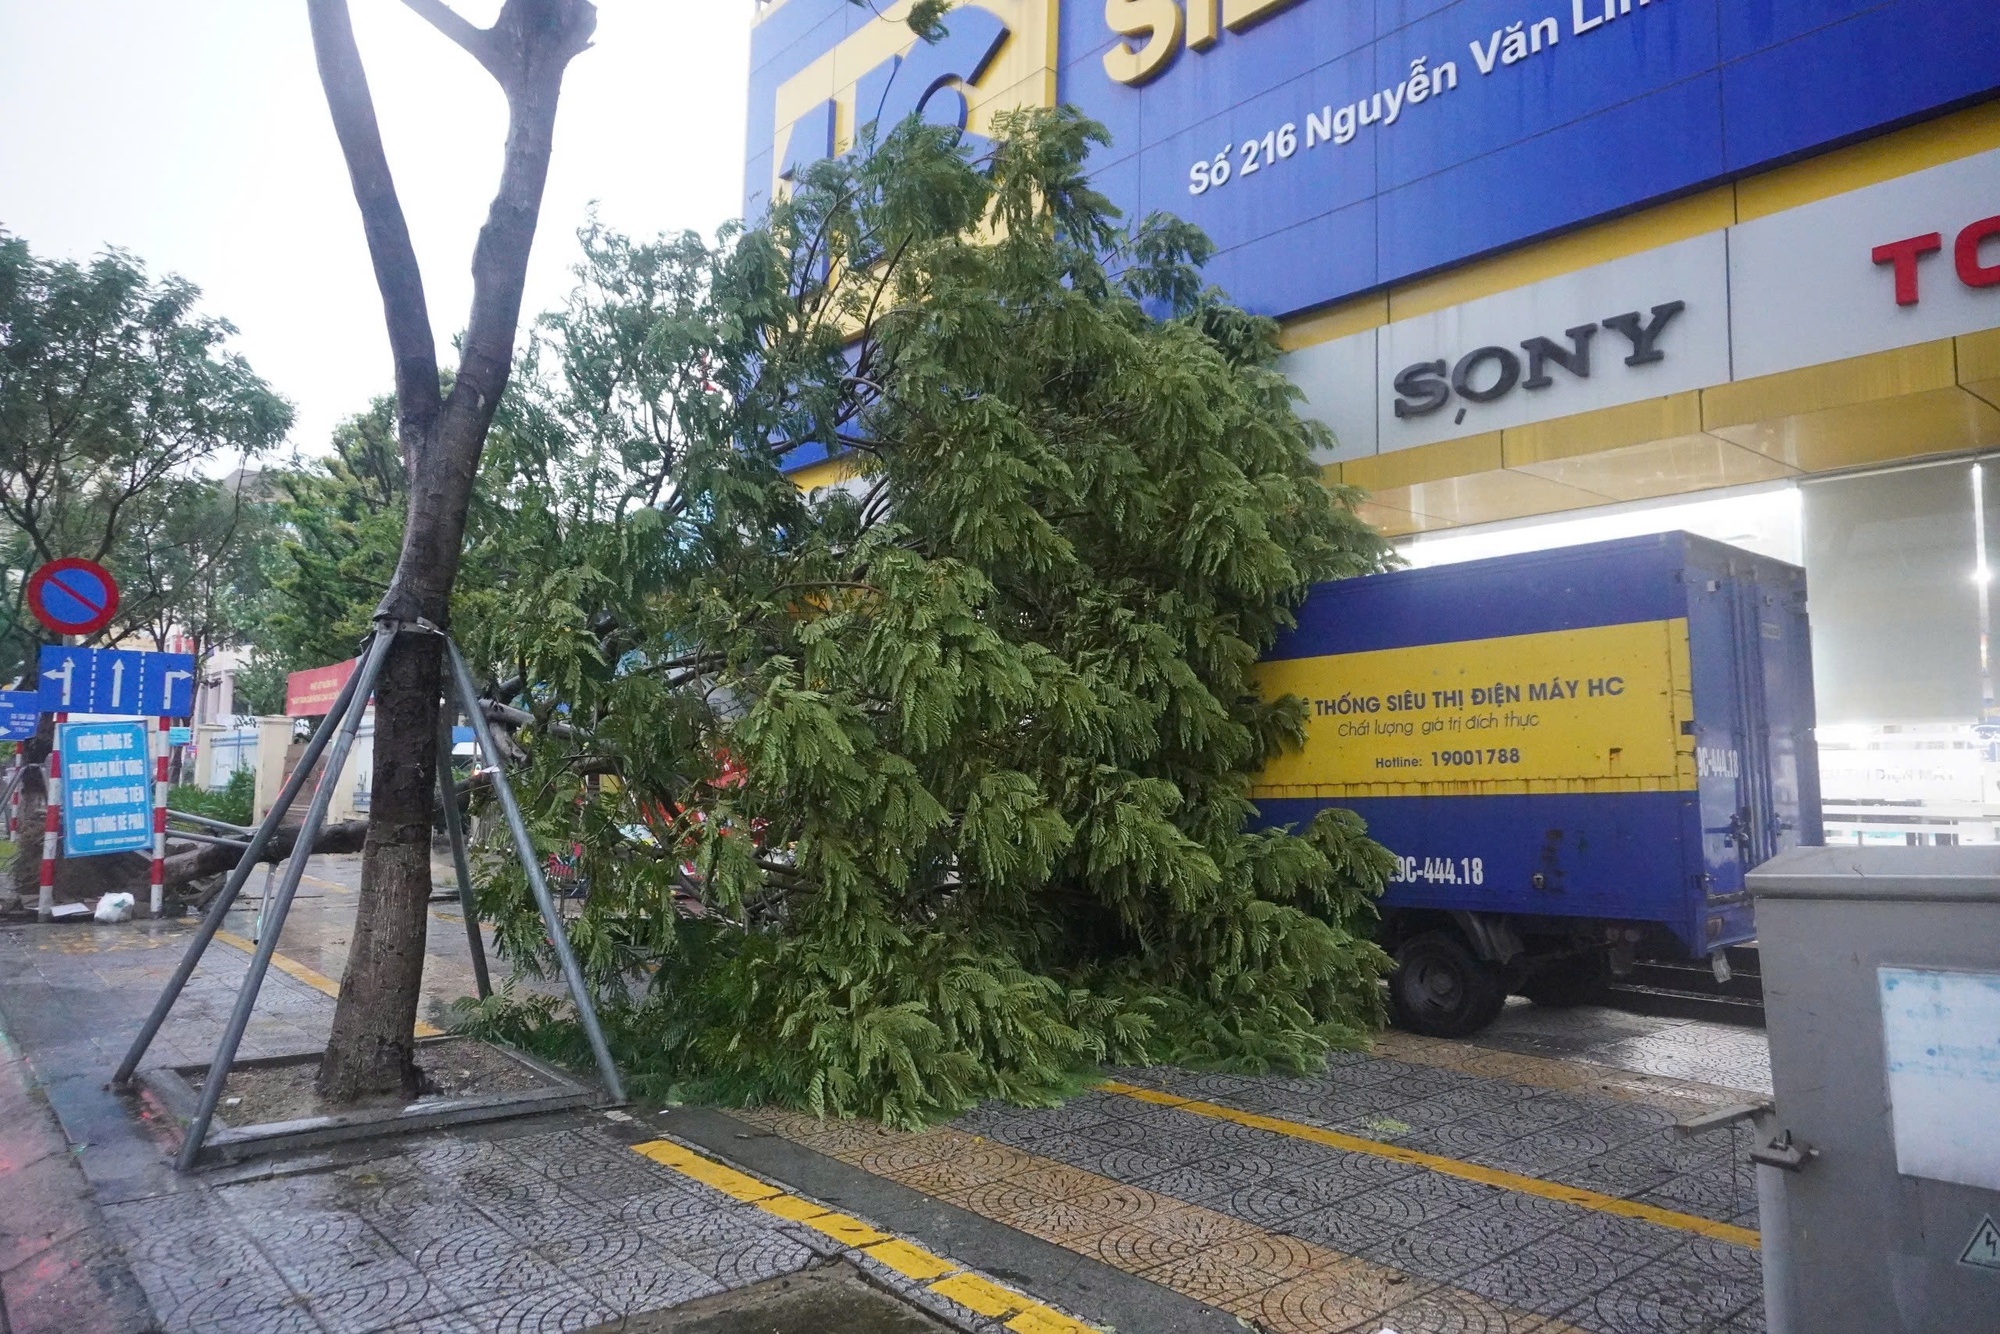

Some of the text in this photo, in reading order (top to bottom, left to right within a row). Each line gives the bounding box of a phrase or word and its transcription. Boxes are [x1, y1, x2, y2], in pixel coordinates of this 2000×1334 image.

[1189, 144, 1232, 195] Số
[1240, 122, 1298, 177] 216
[1304, 55, 1458, 148] Nguyễn
[1468, 16, 1559, 76] Văn
[1394, 300, 1685, 419] SONY
[1315, 691, 1381, 716] THỐNG
[1387, 689, 1426, 712] SIÊU
[1432, 689, 1464, 711] THỊ
[1470, 682, 1521, 708] ĐIỆN
[1528, 676, 1579, 702] MÁY
[1588, 676, 1625, 697] HC
[1338, 710, 1540, 737] Chất lượng giá trị đích thực
[1375, 748, 1520, 769] Hotline: 19001788
